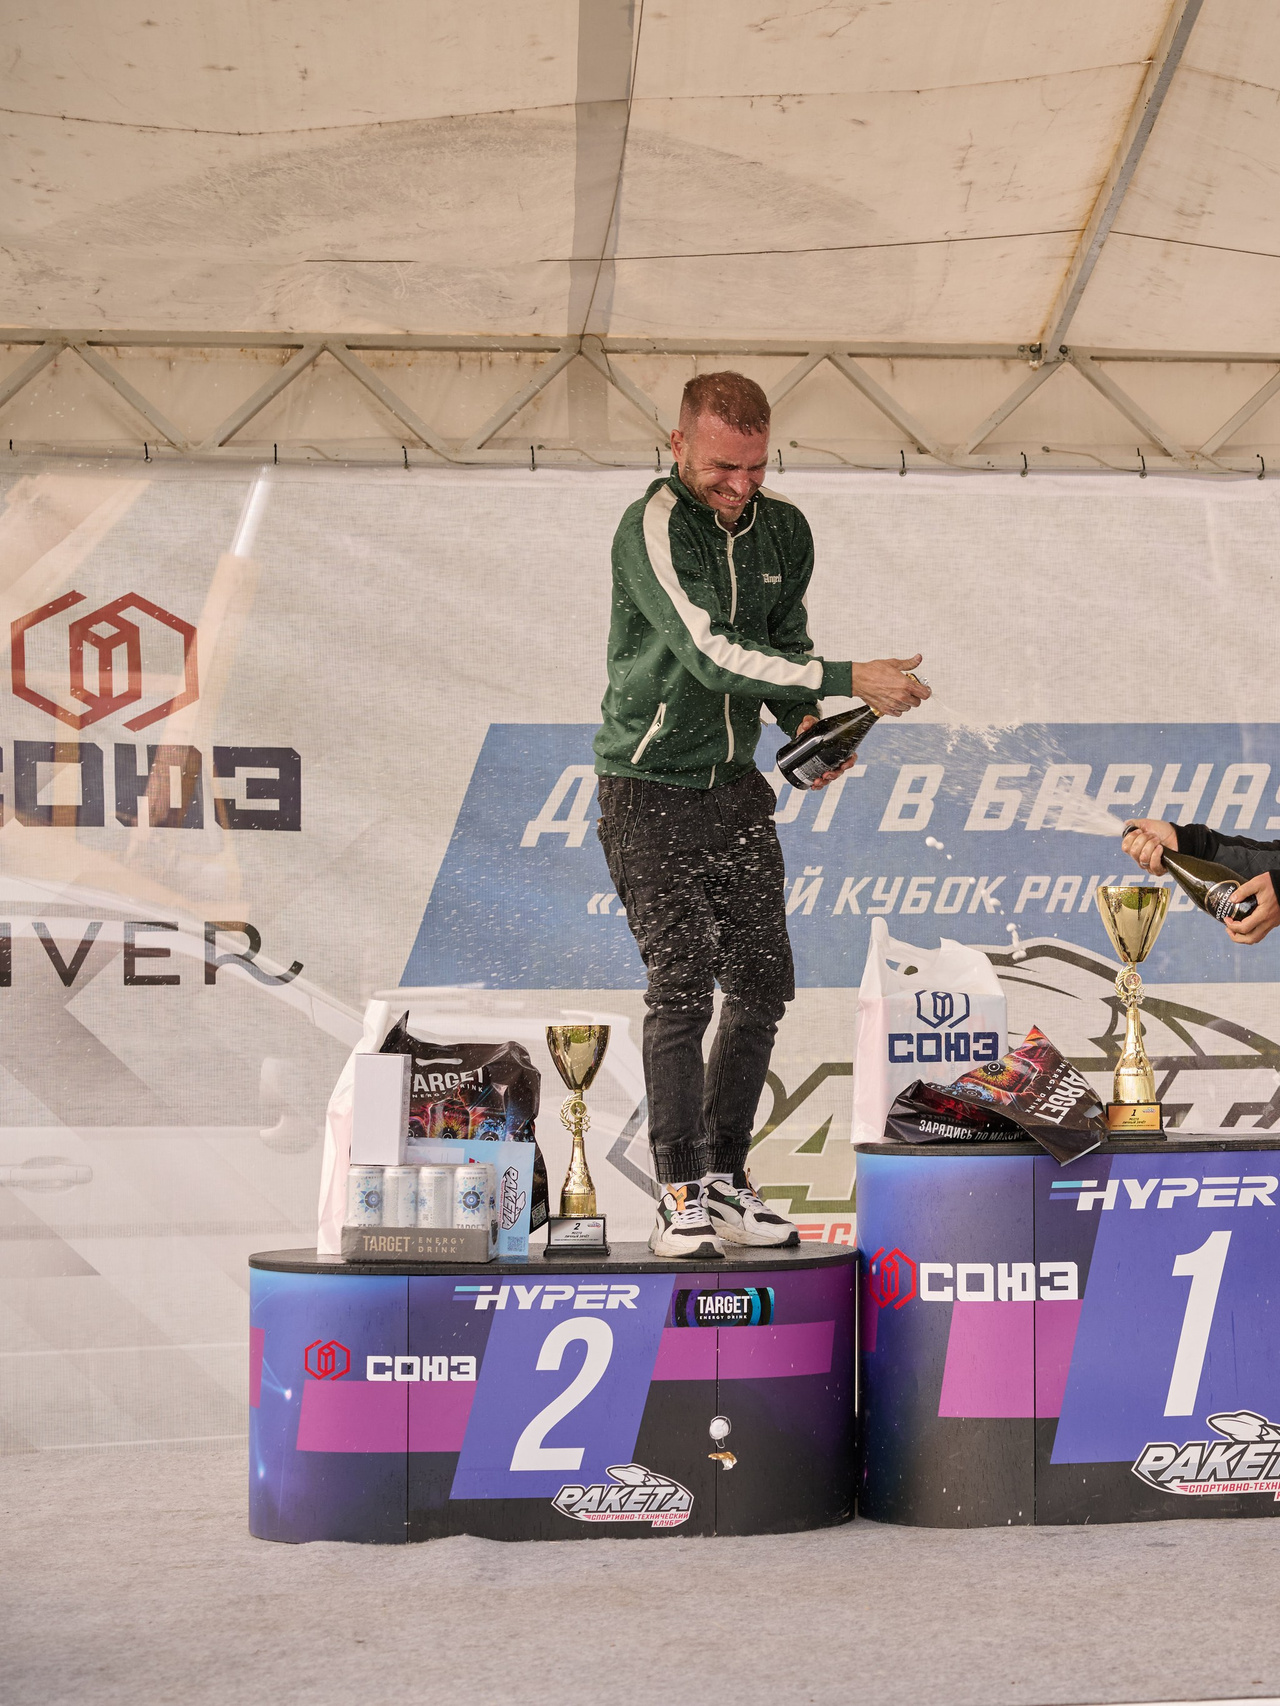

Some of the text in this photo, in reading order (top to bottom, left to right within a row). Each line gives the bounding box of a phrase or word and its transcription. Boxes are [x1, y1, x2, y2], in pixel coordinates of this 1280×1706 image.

[0, 740, 301, 832] ОЮЗ
[878, 763, 946, 832] В
[832, 875, 1006, 916] КУБОК
[887, 1031, 999, 1064] СОЮЗ
[411, 1067, 484, 1092] ARGET
[412, 1090, 447, 1099] NERGY
[1024, 1092, 1047, 1114] DRINK
[1130, 1108, 1137, 1117] 1
[918, 1119, 973, 1140] ЗАРЯДИСЬ
[501, 1166, 519, 1231] РАКЕТА
[1076, 1175, 1280, 1211] HYPER
[573, 1222, 581, 1231] 2
[363, 1235, 465, 1253] TARGET ENERGY
[418, 1246, 456, 1254] DRINK
[919, 1261, 1079, 1302] СОЮЗ
[473, 1284, 641, 1310] HYPER
[697, 1295, 751, 1314] TARGET
[1163, 1230, 1232, 1418] 1
[366, 1355, 477, 1382] СОЮЗ
[509, 1316, 614, 1472] 2
[552, 1485, 692, 1513] РАКЕТА
[590, 1511, 689, 1521] СПОРТИВНО-ТЕХНИЧЕСКИЙ
[653, 1519, 675, 1527] КЛУБ
